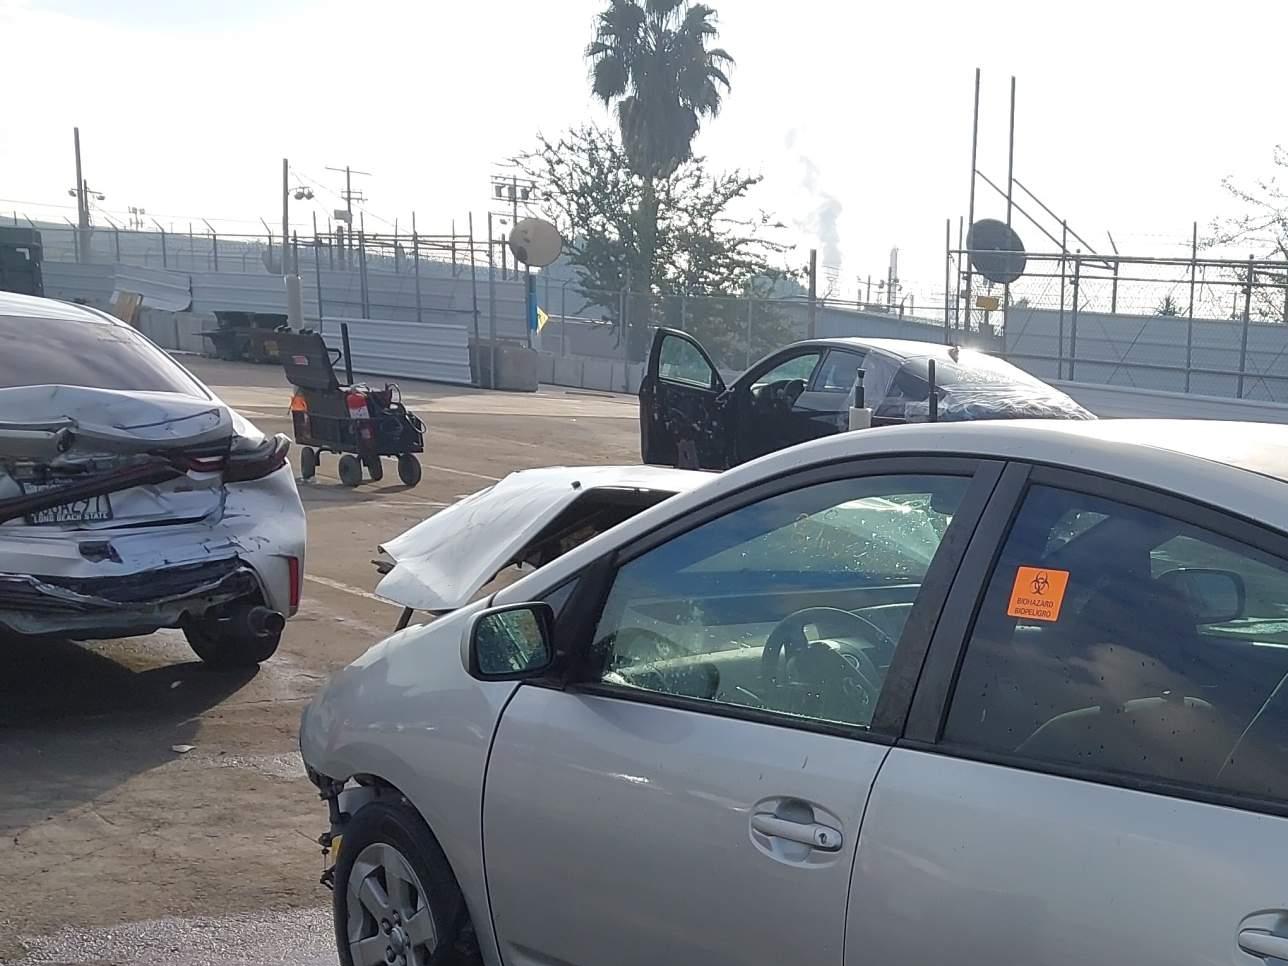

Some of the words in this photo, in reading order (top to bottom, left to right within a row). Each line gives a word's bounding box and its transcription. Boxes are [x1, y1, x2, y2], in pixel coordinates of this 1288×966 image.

[84, 511, 108, 520] STATE
[1016, 597, 1054, 609] BIOHAZARD
[1014, 607, 1052, 618] BIOPELIGRO
